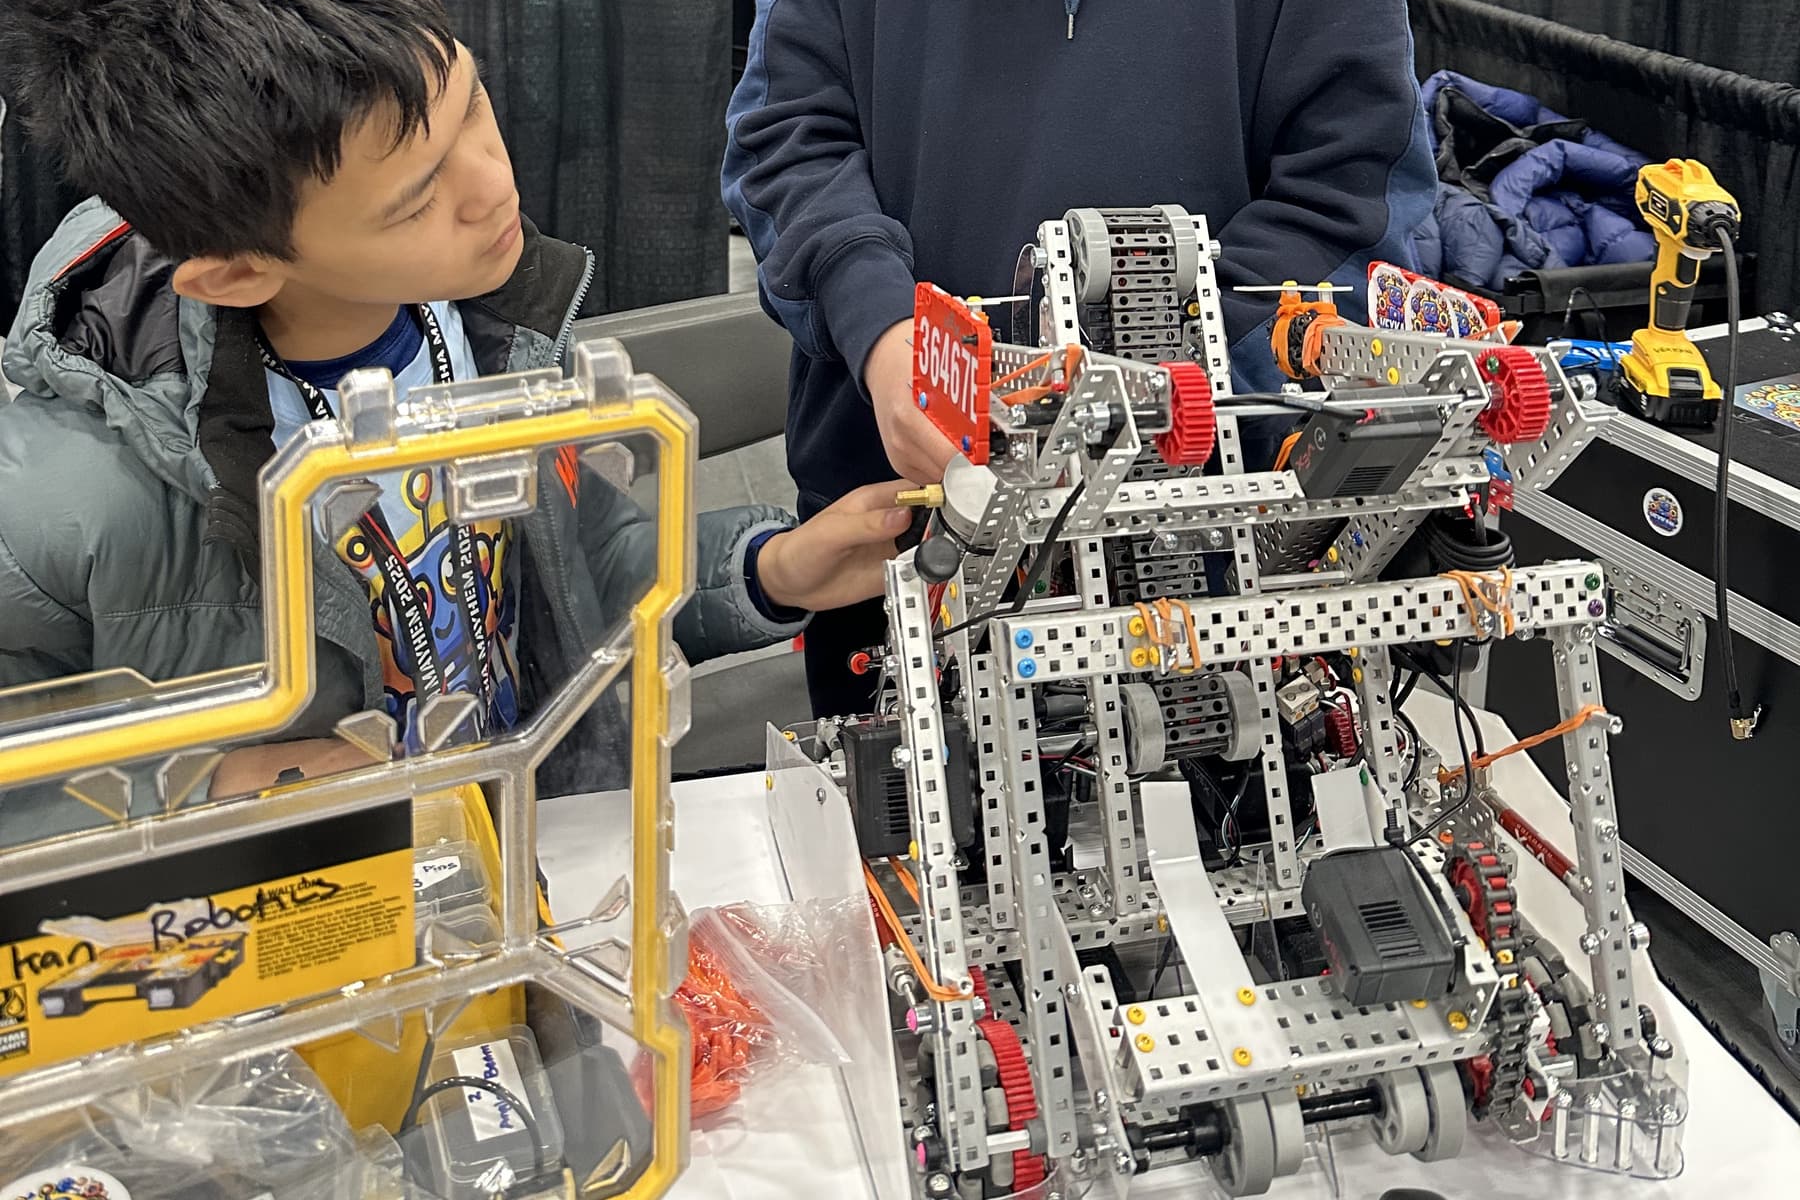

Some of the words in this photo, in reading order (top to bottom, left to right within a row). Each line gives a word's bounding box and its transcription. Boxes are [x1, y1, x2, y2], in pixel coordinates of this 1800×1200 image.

[421, 304, 443, 346] MAY
[918, 315, 978, 425] 36467E
[457, 526, 473, 568] 202
[385, 554, 414, 608] 2025
[461, 569, 486, 661] MAYHEM
[405, 604, 440, 692] MAYHEM
[422, 862, 458, 873] Pins
[152, 878, 341, 951] Robotics
